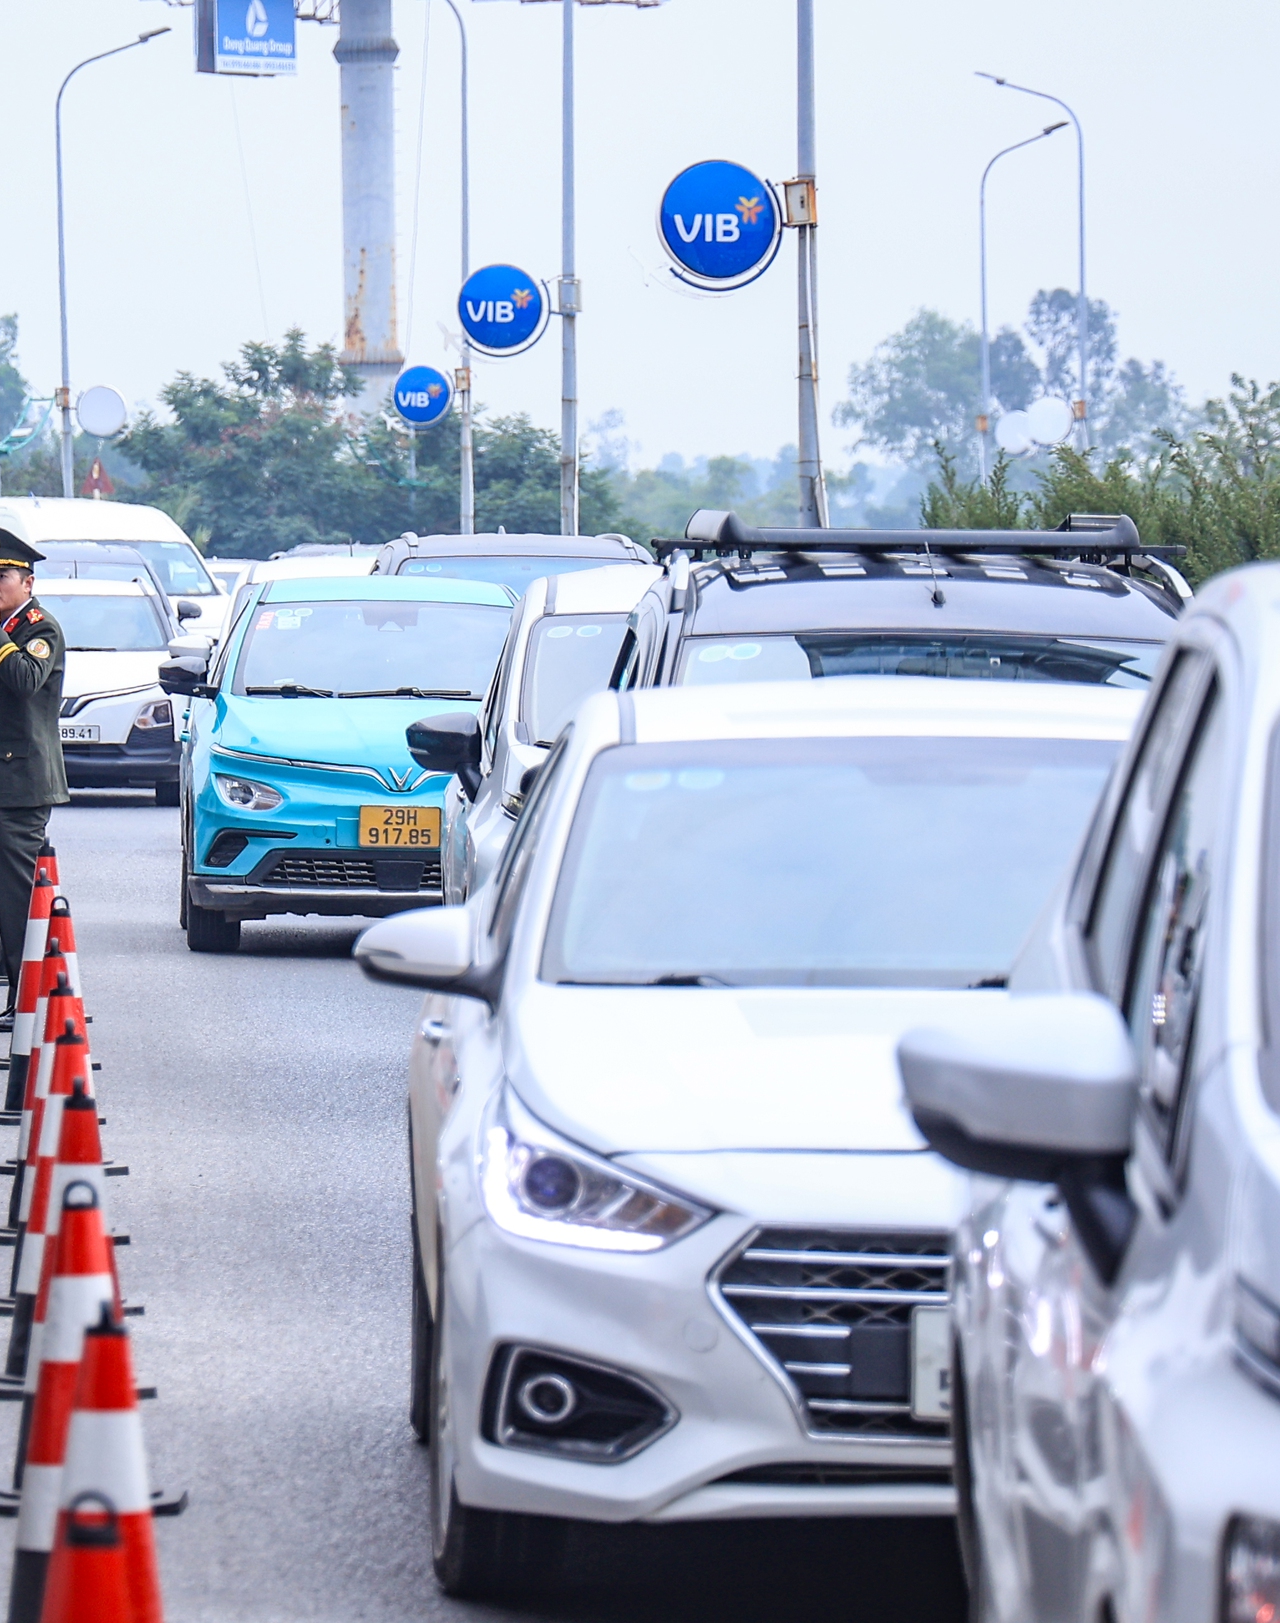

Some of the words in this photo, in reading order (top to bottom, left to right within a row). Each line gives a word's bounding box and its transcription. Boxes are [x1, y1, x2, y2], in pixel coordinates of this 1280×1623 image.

[269, 38, 293, 57] Group
[674, 213, 740, 243] VIB
[466, 300, 514, 323] VIB
[397, 391, 430, 408] VIB
[59, 728, 93, 739] 89.41
[383, 809, 418, 826] 29H
[368, 828, 432, 845] 917.85
